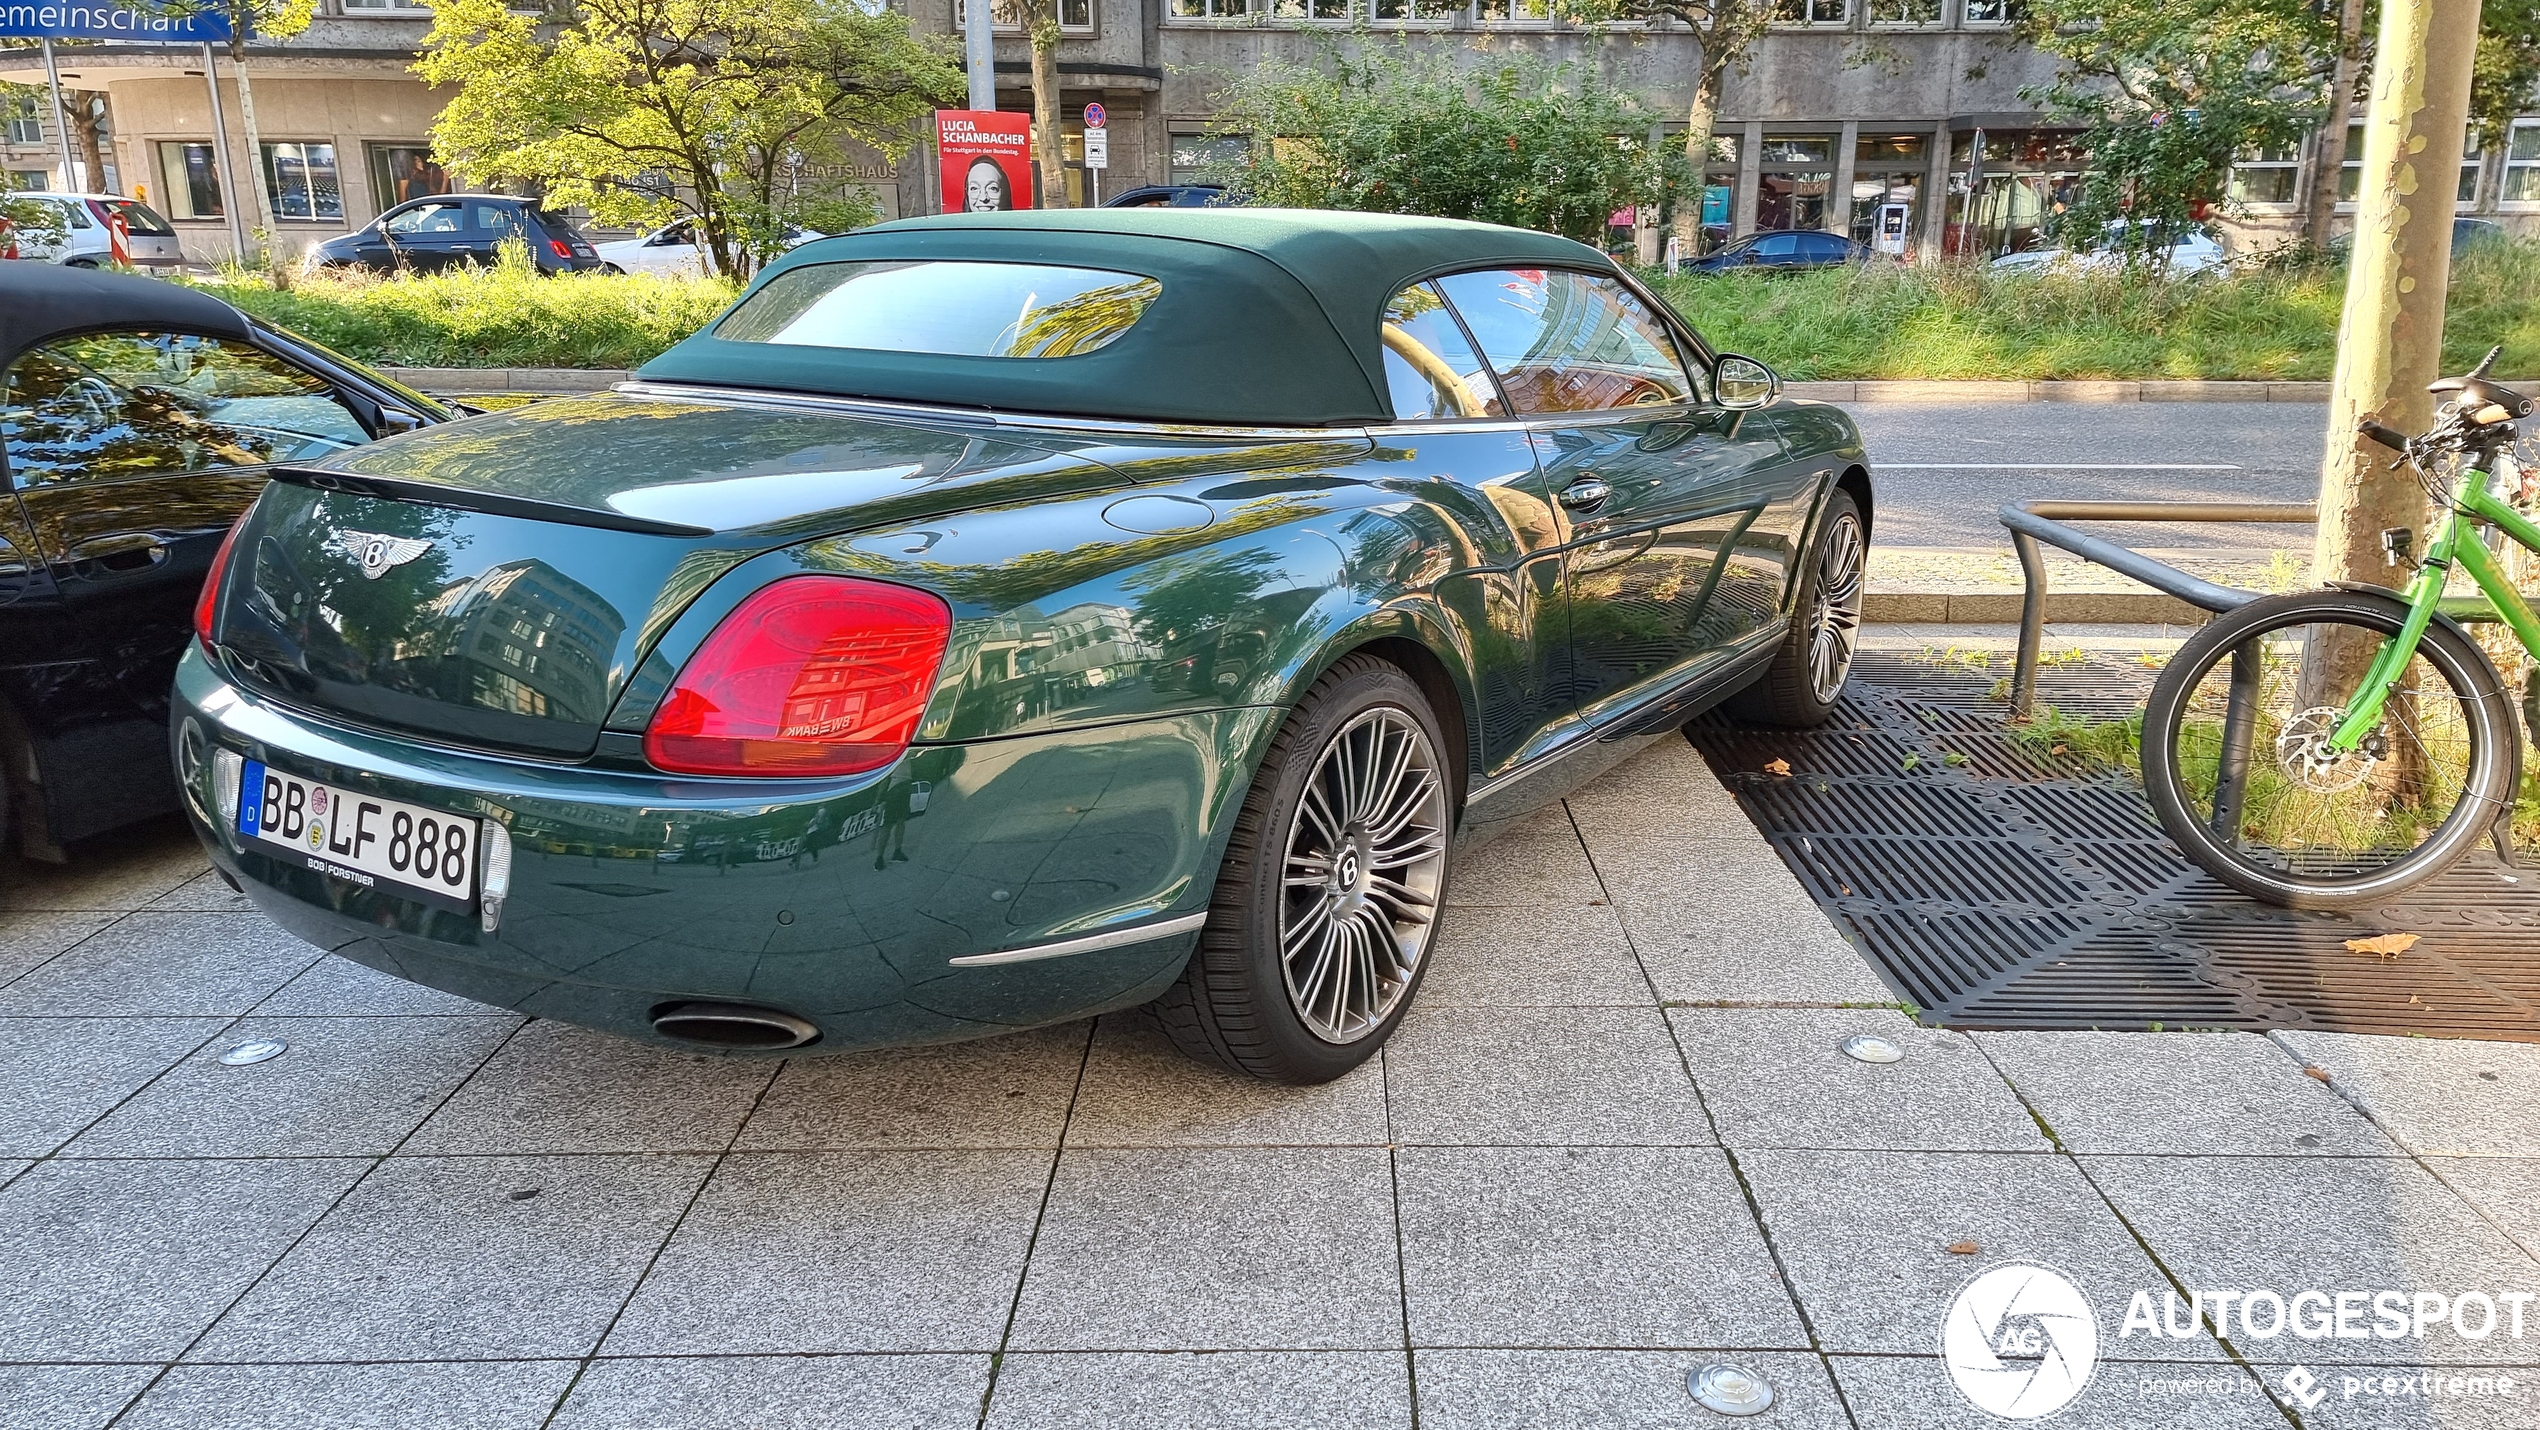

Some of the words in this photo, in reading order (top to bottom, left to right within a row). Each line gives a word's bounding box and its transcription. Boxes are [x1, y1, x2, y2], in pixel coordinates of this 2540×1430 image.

[942, 120, 976, 131] LUCIA
[942, 132, 1025, 145] SCHANBACHER
[247, 806, 255, 821] D
[261, 775, 306, 840] BB
[329, 794, 382, 859] LF
[389, 811, 467, 886] 888
[307, 857, 325, 871] BOB
[328, 865, 374, 887] FORSTNER
